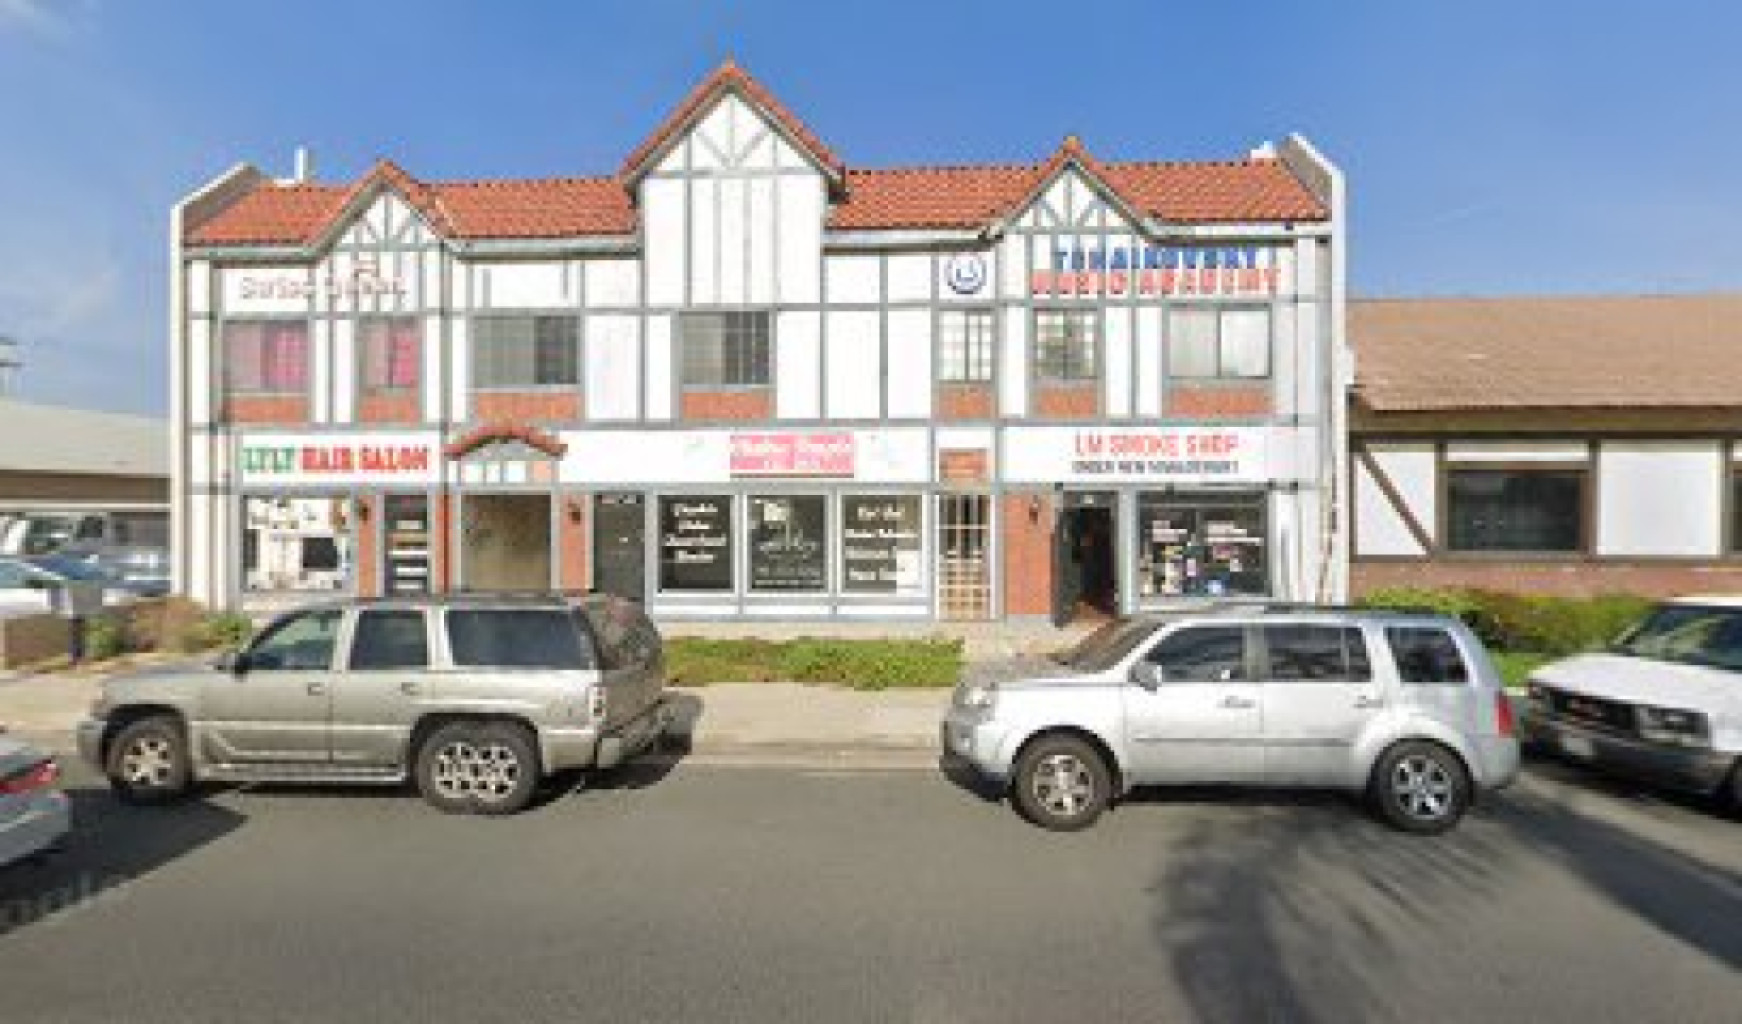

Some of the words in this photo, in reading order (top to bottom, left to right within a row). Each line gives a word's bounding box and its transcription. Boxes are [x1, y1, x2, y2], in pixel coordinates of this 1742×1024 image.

[1031, 269, 1129, 295] MUSIC
[1137, 269, 1280, 295] ACADEMY
[1110, 434, 1179, 456] SMOKE
[1187, 434, 1239, 455] SHOP
[303, 446, 354, 473] HAIR
[360, 446, 428, 473] SALON
[1072, 461, 1114, 473] UNDER
[1119, 461, 1145, 473] NEW
